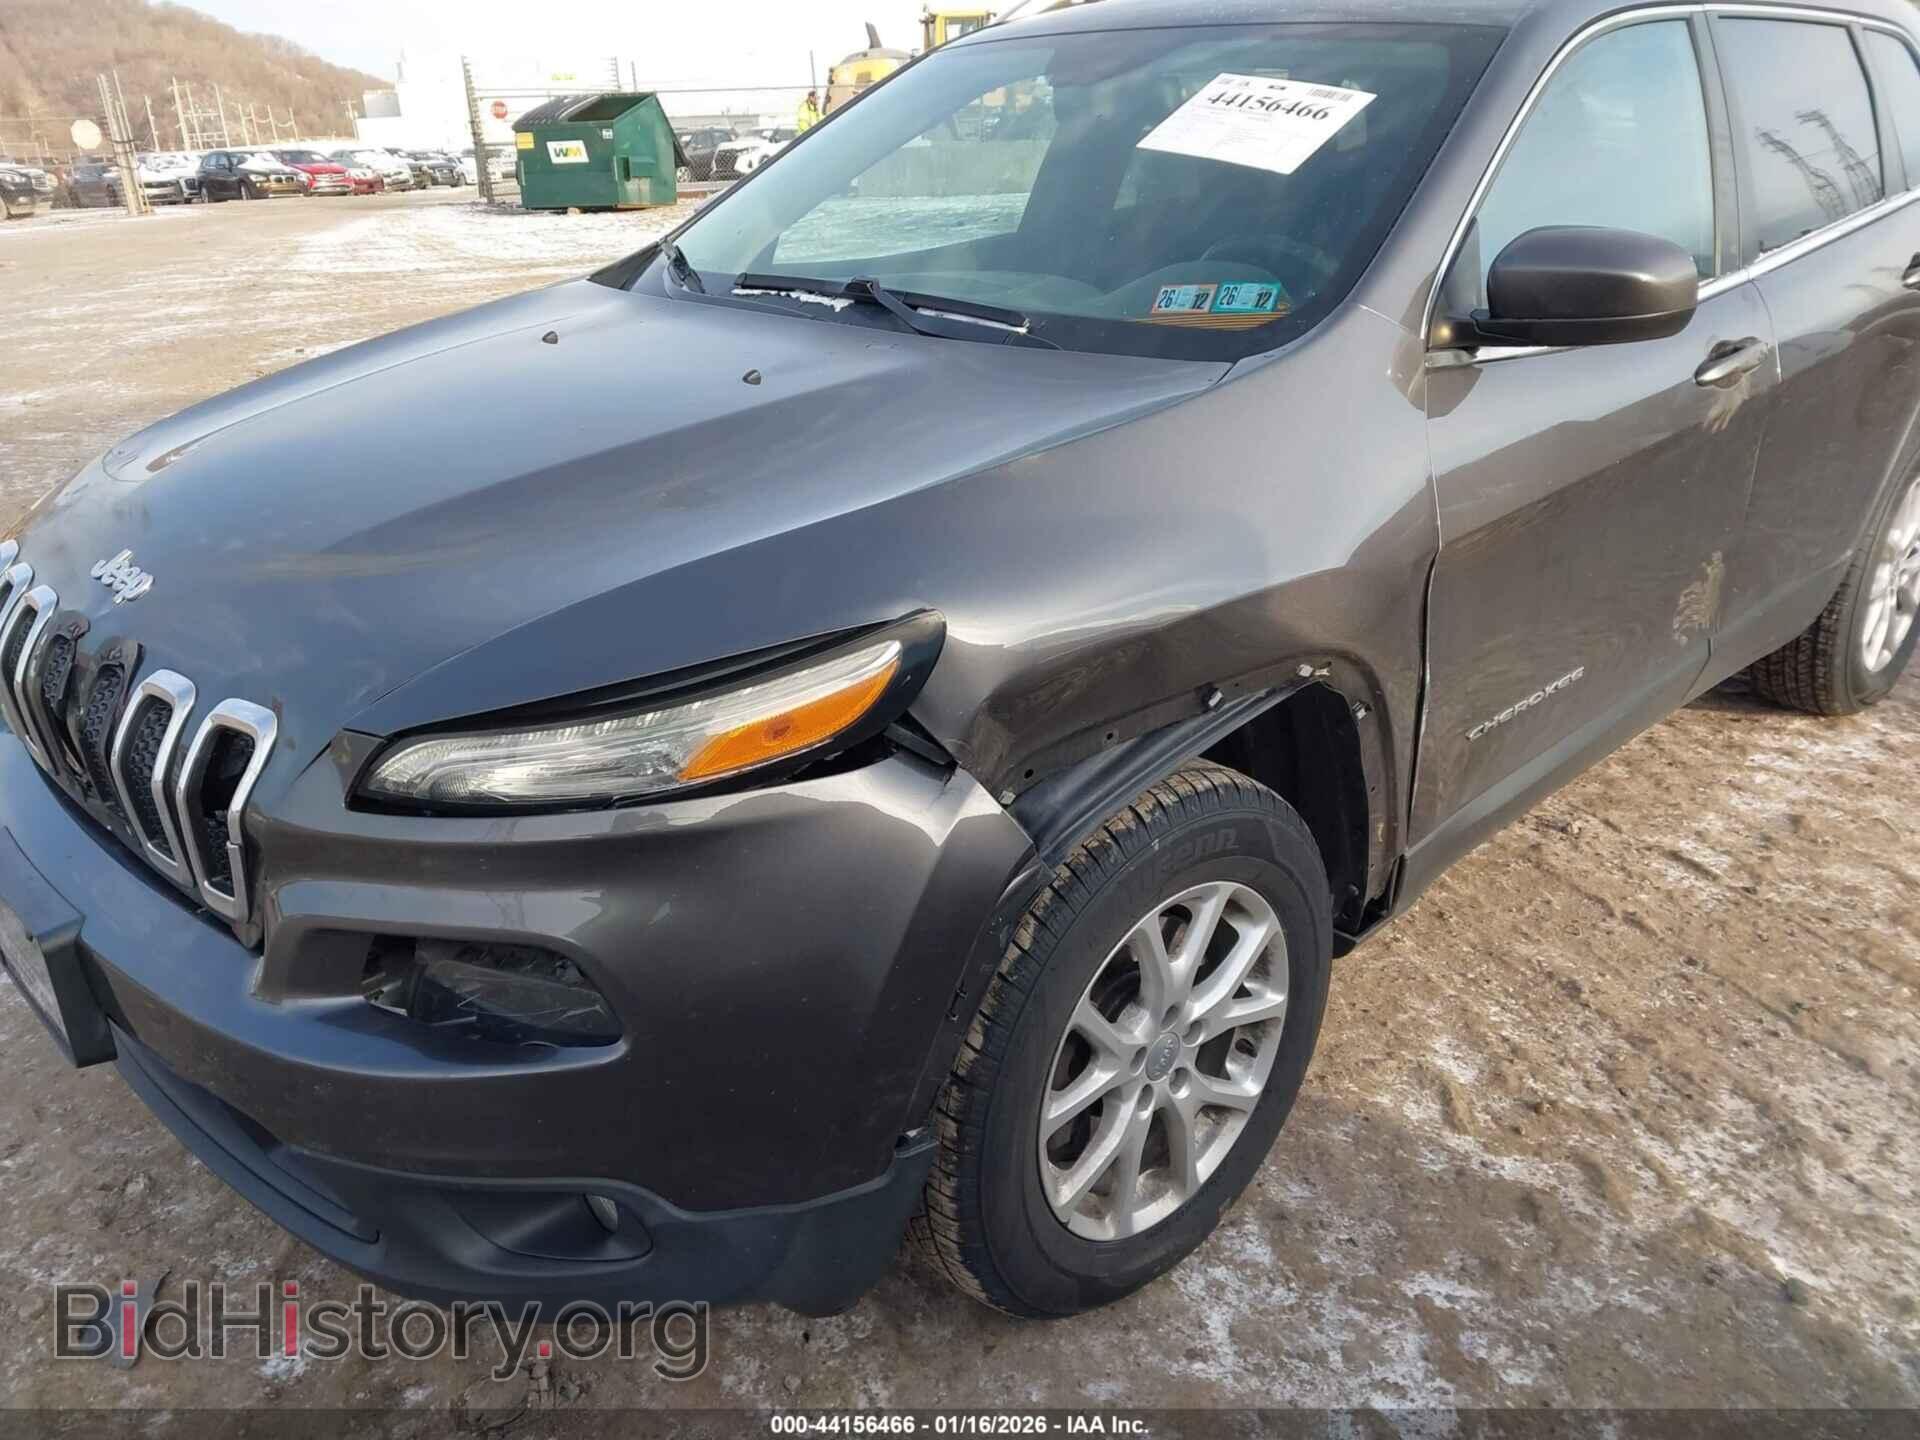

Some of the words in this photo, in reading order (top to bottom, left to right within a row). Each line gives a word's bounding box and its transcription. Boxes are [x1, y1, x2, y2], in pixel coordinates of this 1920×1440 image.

[1207, 91, 1334, 120] 44156466
[553, 146, 582, 158] WM
[1157, 289, 1176, 309] 26
[1191, 293, 1209, 310] 12
[1220, 287, 1238, 306] 26
[1254, 291, 1274, 309] 12
[90, 548, 155, 604] Jeep
